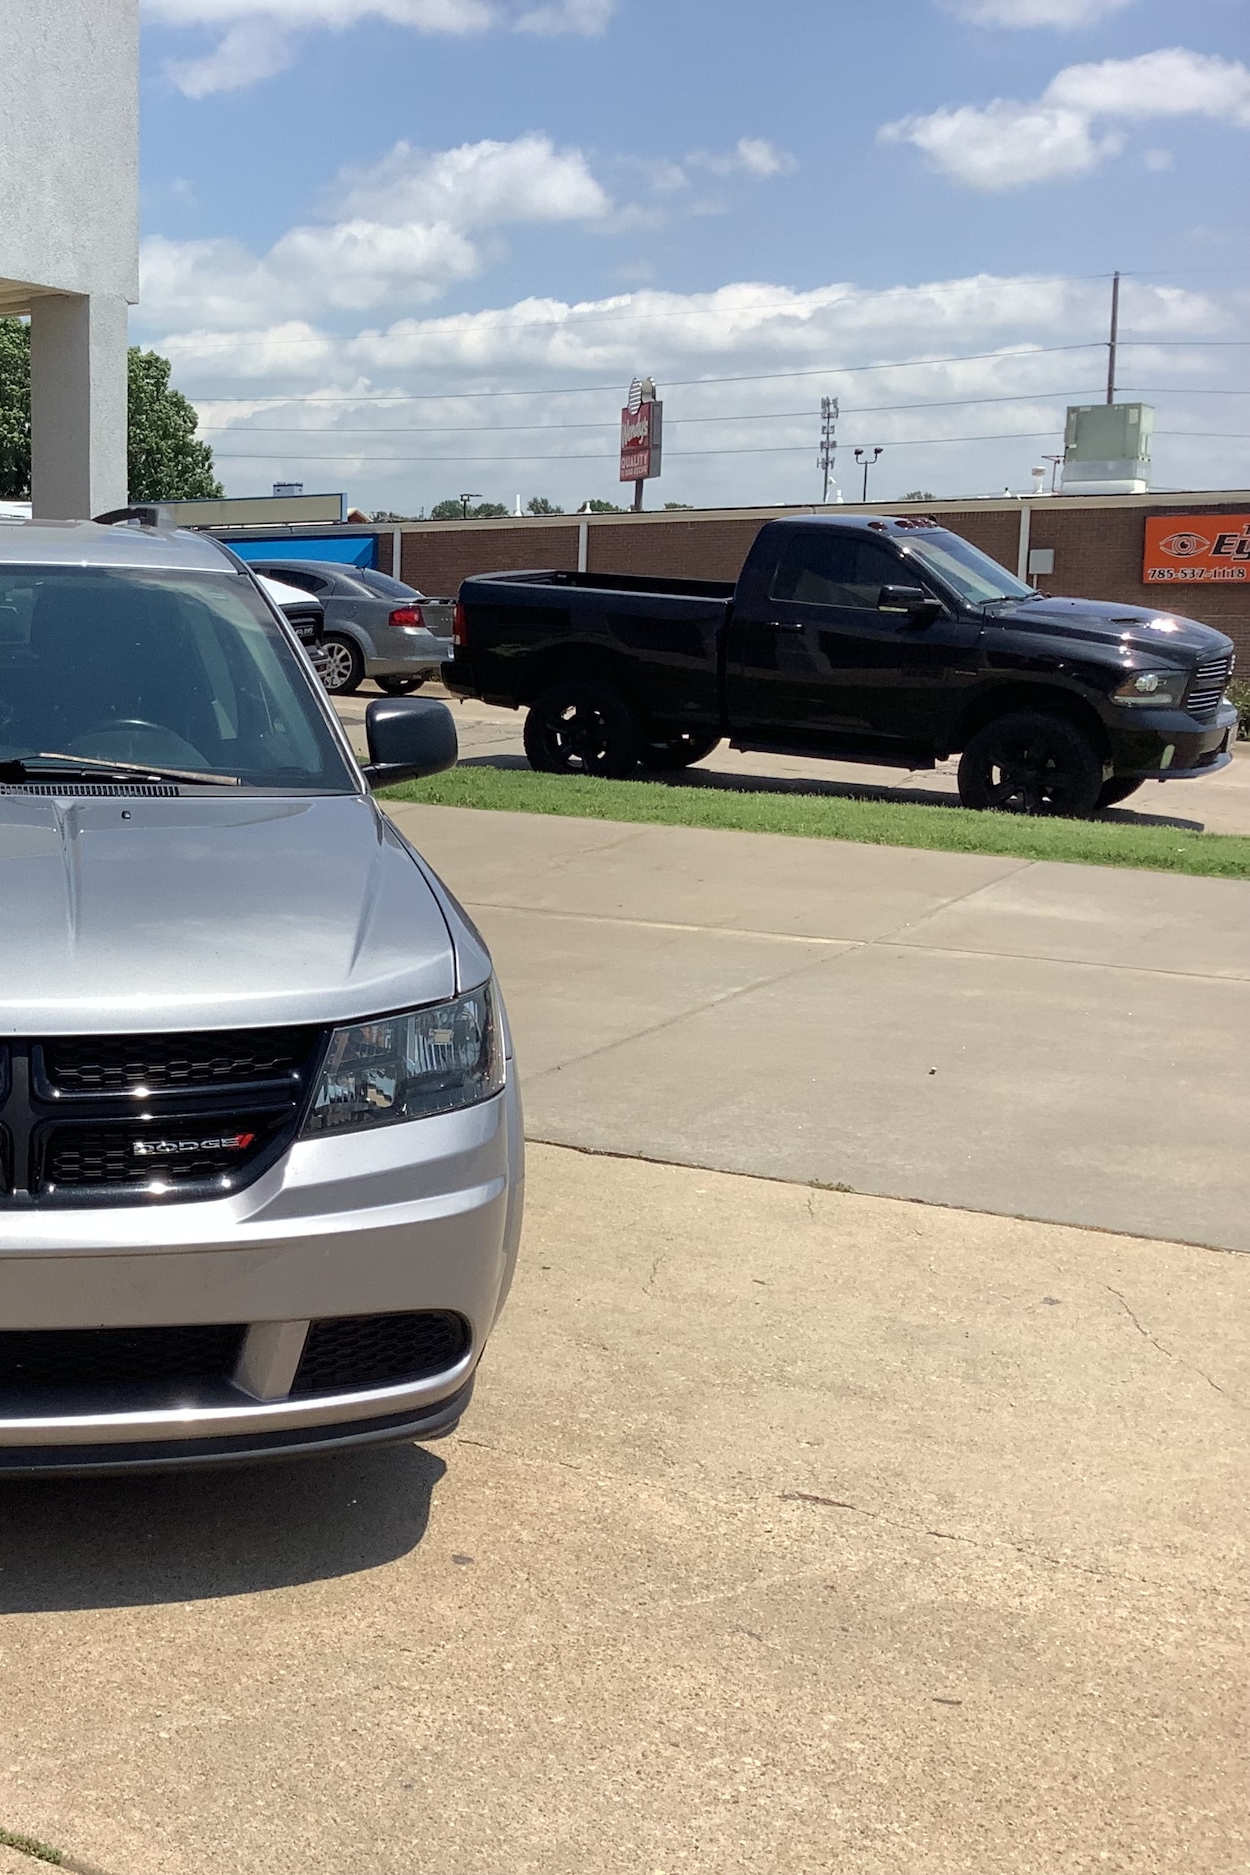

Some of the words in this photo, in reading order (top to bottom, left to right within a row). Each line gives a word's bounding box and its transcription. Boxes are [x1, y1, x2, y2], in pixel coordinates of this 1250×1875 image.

[621, 450, 648, 469] QUALITY
[1148, 566, 1247, 581] 785-537-1118
[133, 1137, 240, 1156] DODGE
